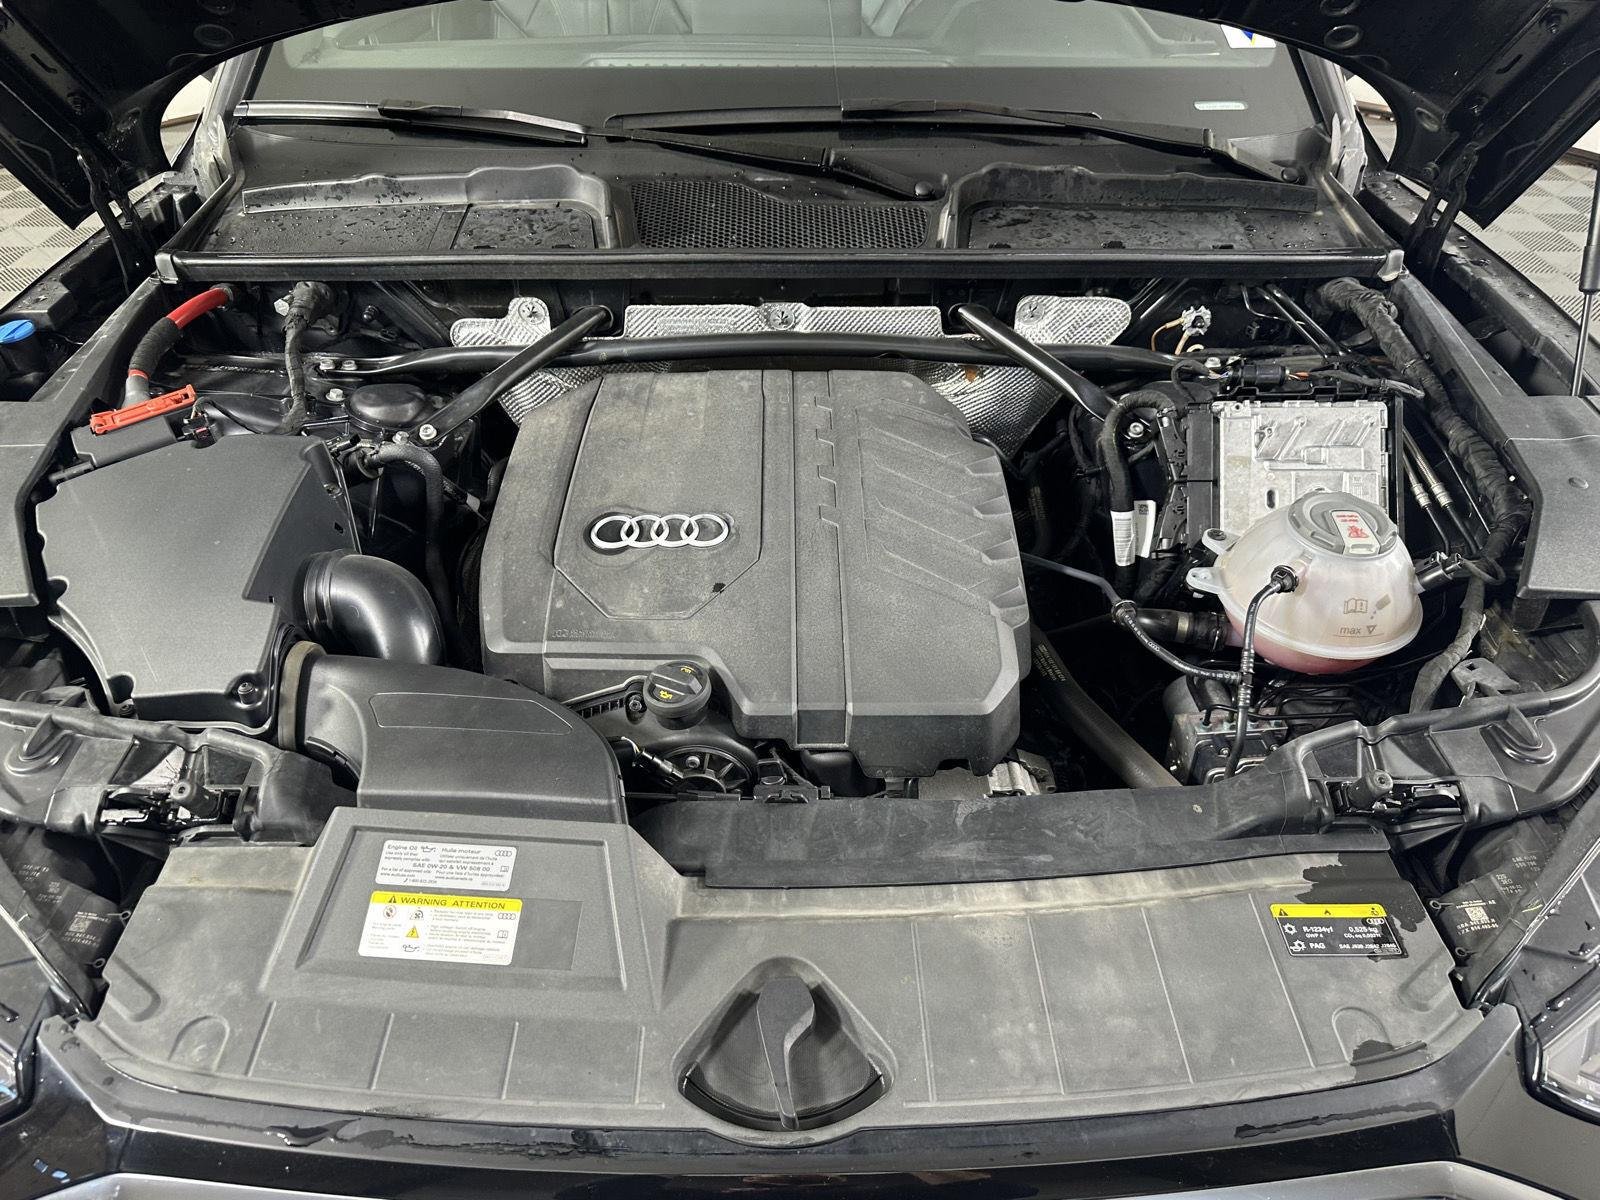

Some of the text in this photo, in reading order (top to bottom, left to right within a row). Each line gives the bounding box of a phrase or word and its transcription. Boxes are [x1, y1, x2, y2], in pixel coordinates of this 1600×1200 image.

[1339, 627, 1361, 635] max
[400, 896, 506, 910] WARNING ATTENTION
[1302, 925, 1334, 934] R-1234yf
[1368, 926, 1379, 934] kg
